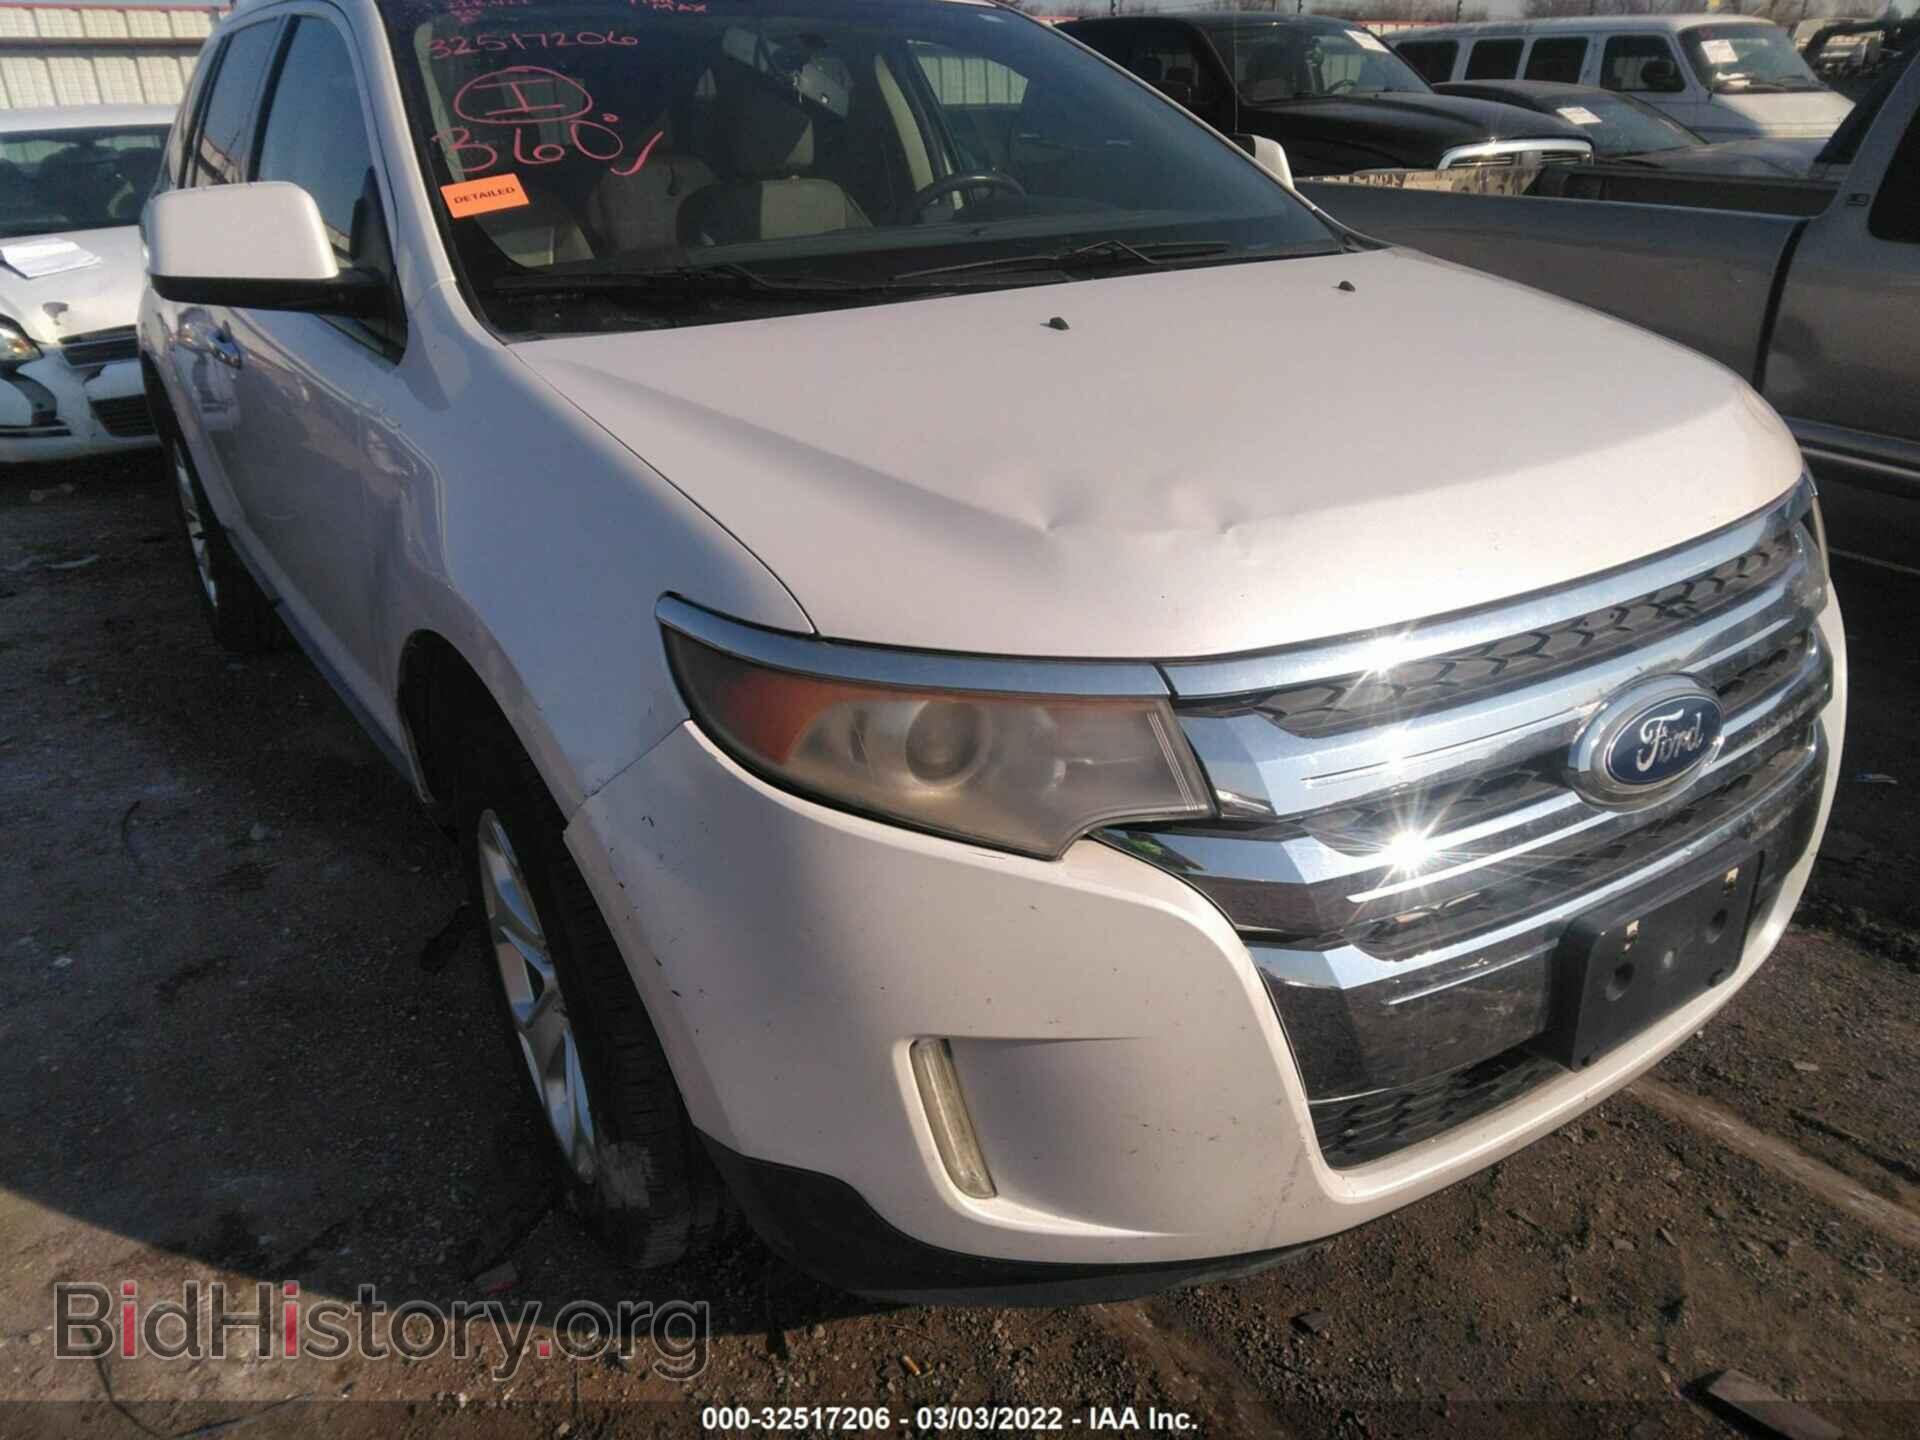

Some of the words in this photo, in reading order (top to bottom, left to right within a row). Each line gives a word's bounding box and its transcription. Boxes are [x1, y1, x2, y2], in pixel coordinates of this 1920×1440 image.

[426, 32, 639, 59] 32517206
[453, 186, 516, 204] DETAILED
[1636, 708, 1704, 772] Ford
